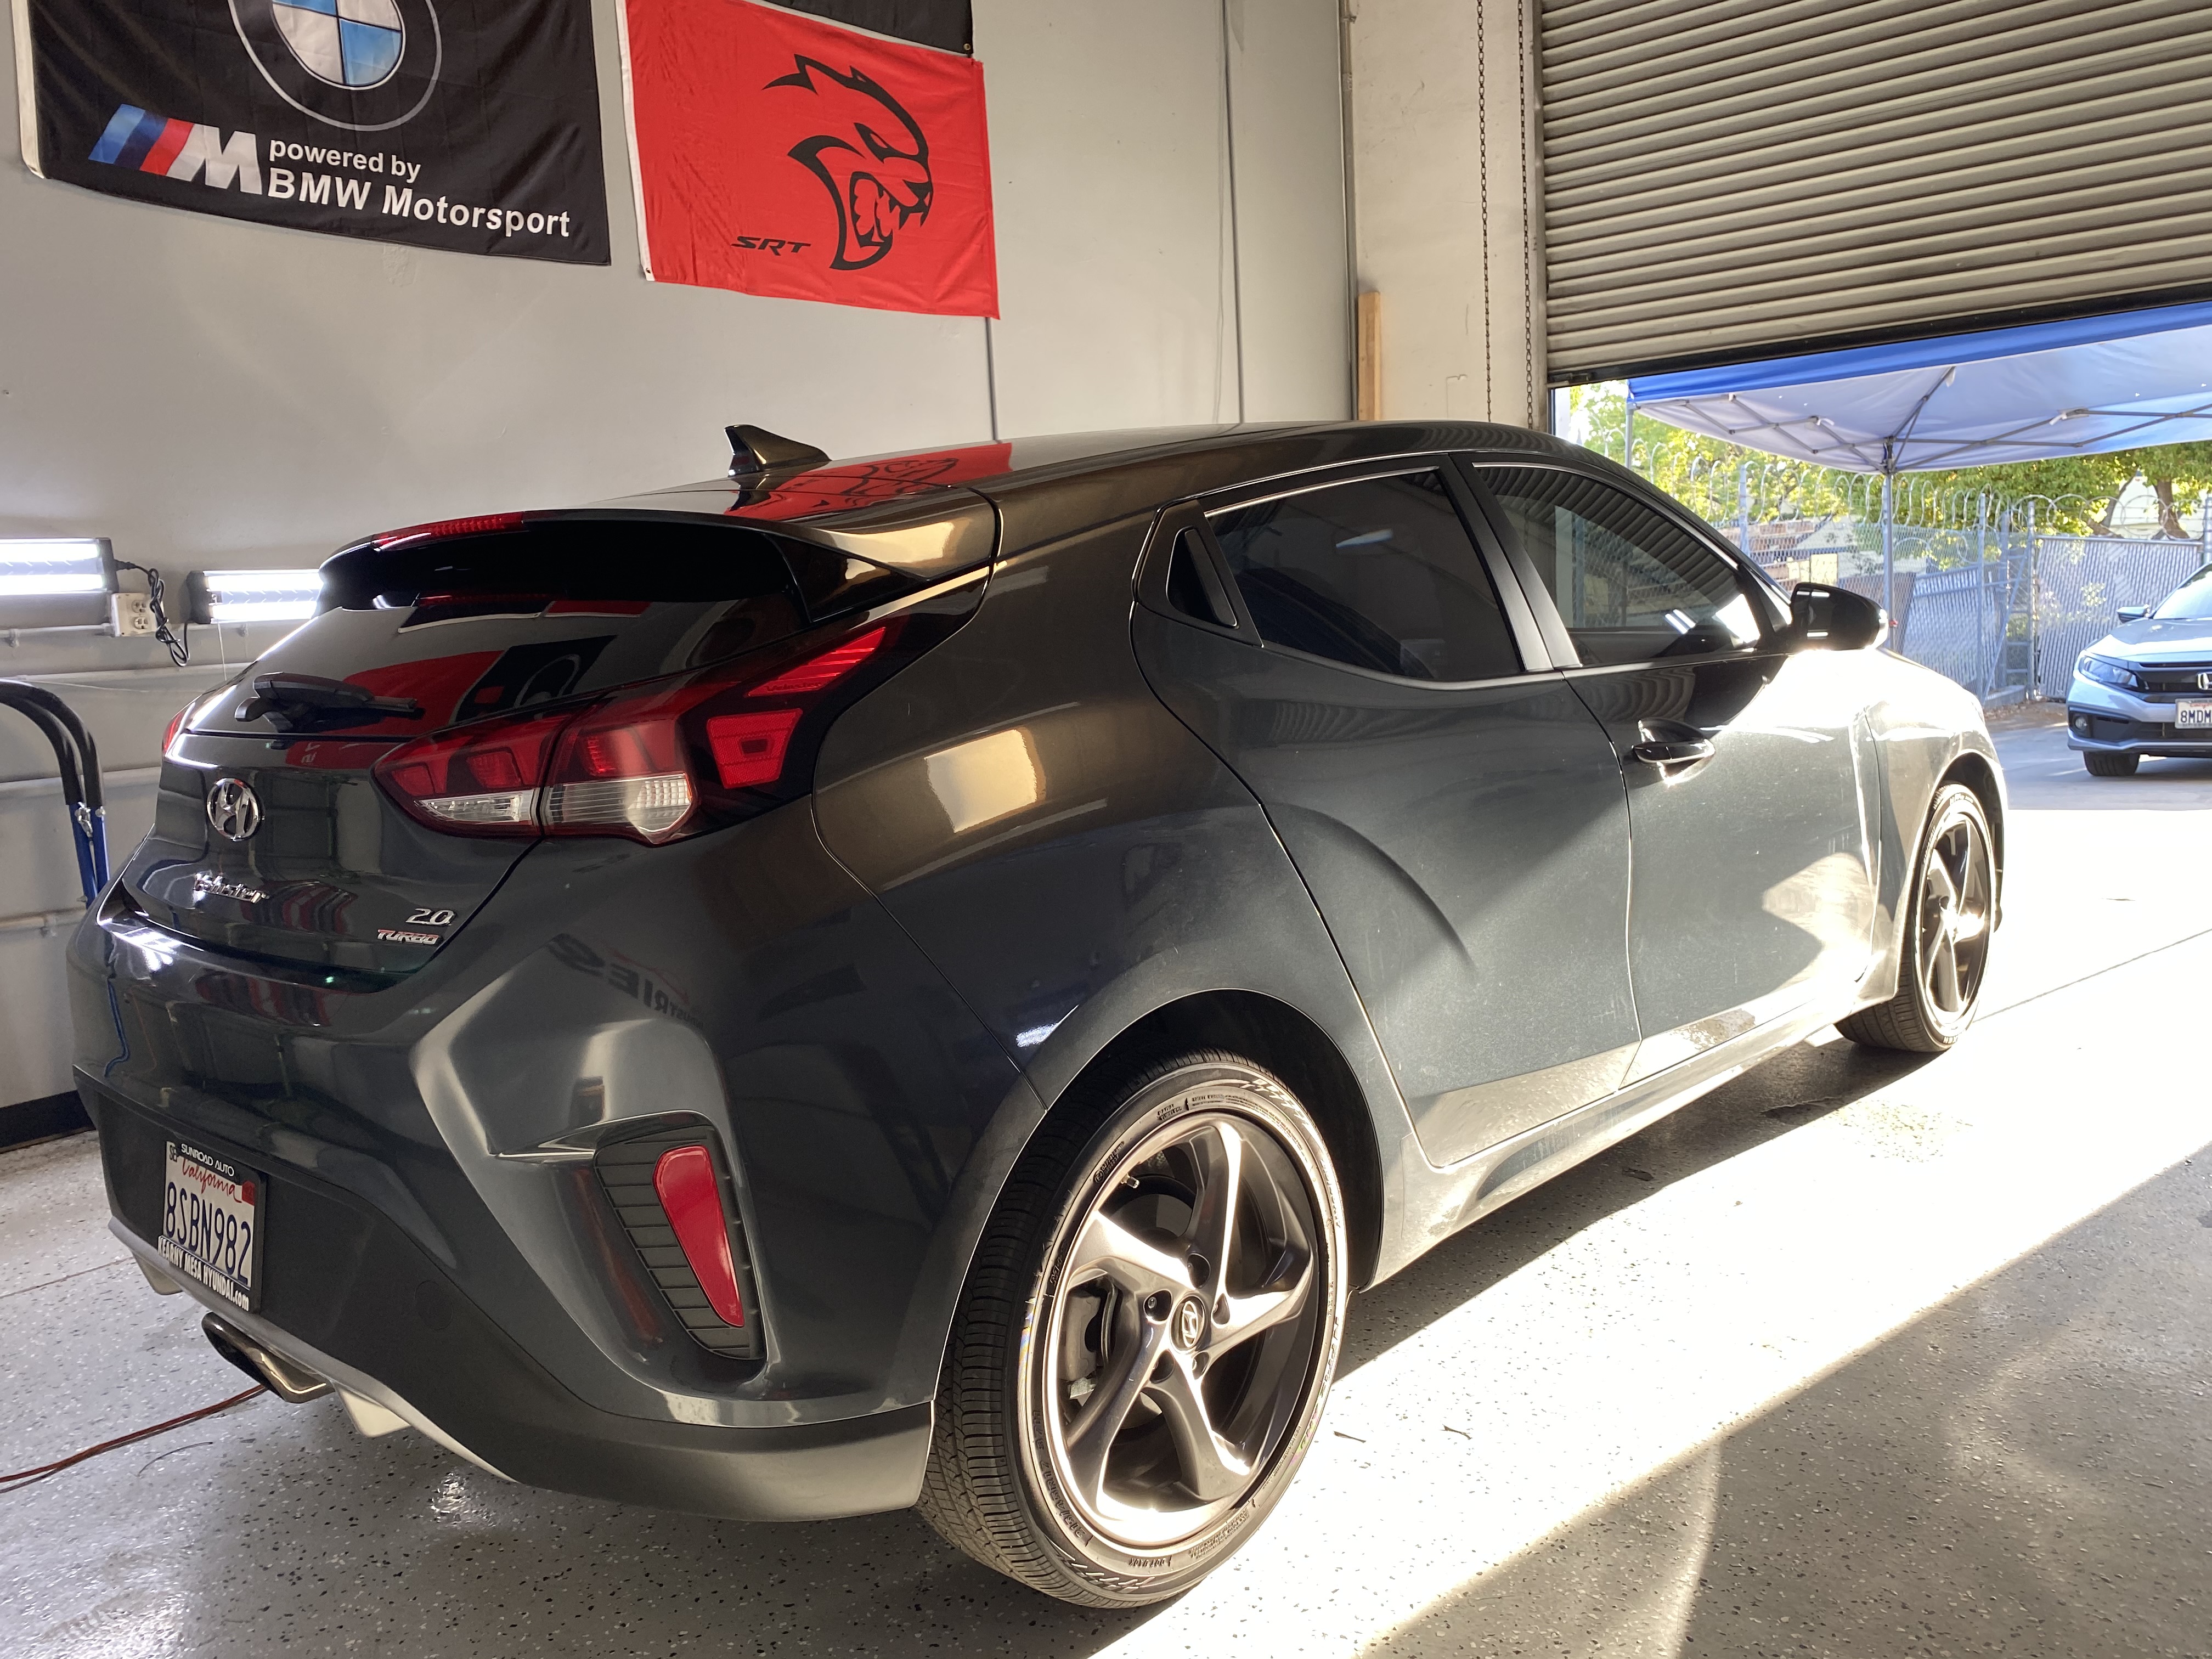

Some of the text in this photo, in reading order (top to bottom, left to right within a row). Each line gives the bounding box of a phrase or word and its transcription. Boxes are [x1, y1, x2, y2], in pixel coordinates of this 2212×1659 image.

[269, 139, 421, 183] powered by
[268, 167, 570, 237] BMW Motorsport
[731, 235, 811, 256] SRT
[2181, 709, 2211, 723] 8MDM
[377, 929, 439, 945] TURBO
[181, 1143, 235, 1177] SUNROAD AUTO
[182, 1158, 242, 1204] California
[166, 1181, 251, 1286] 8SBN982
[158, 1235, 250, 1312] KEARNY MESA HYUNDAI.com
[1039, 1460, 1087, 1539] 215/45R17
